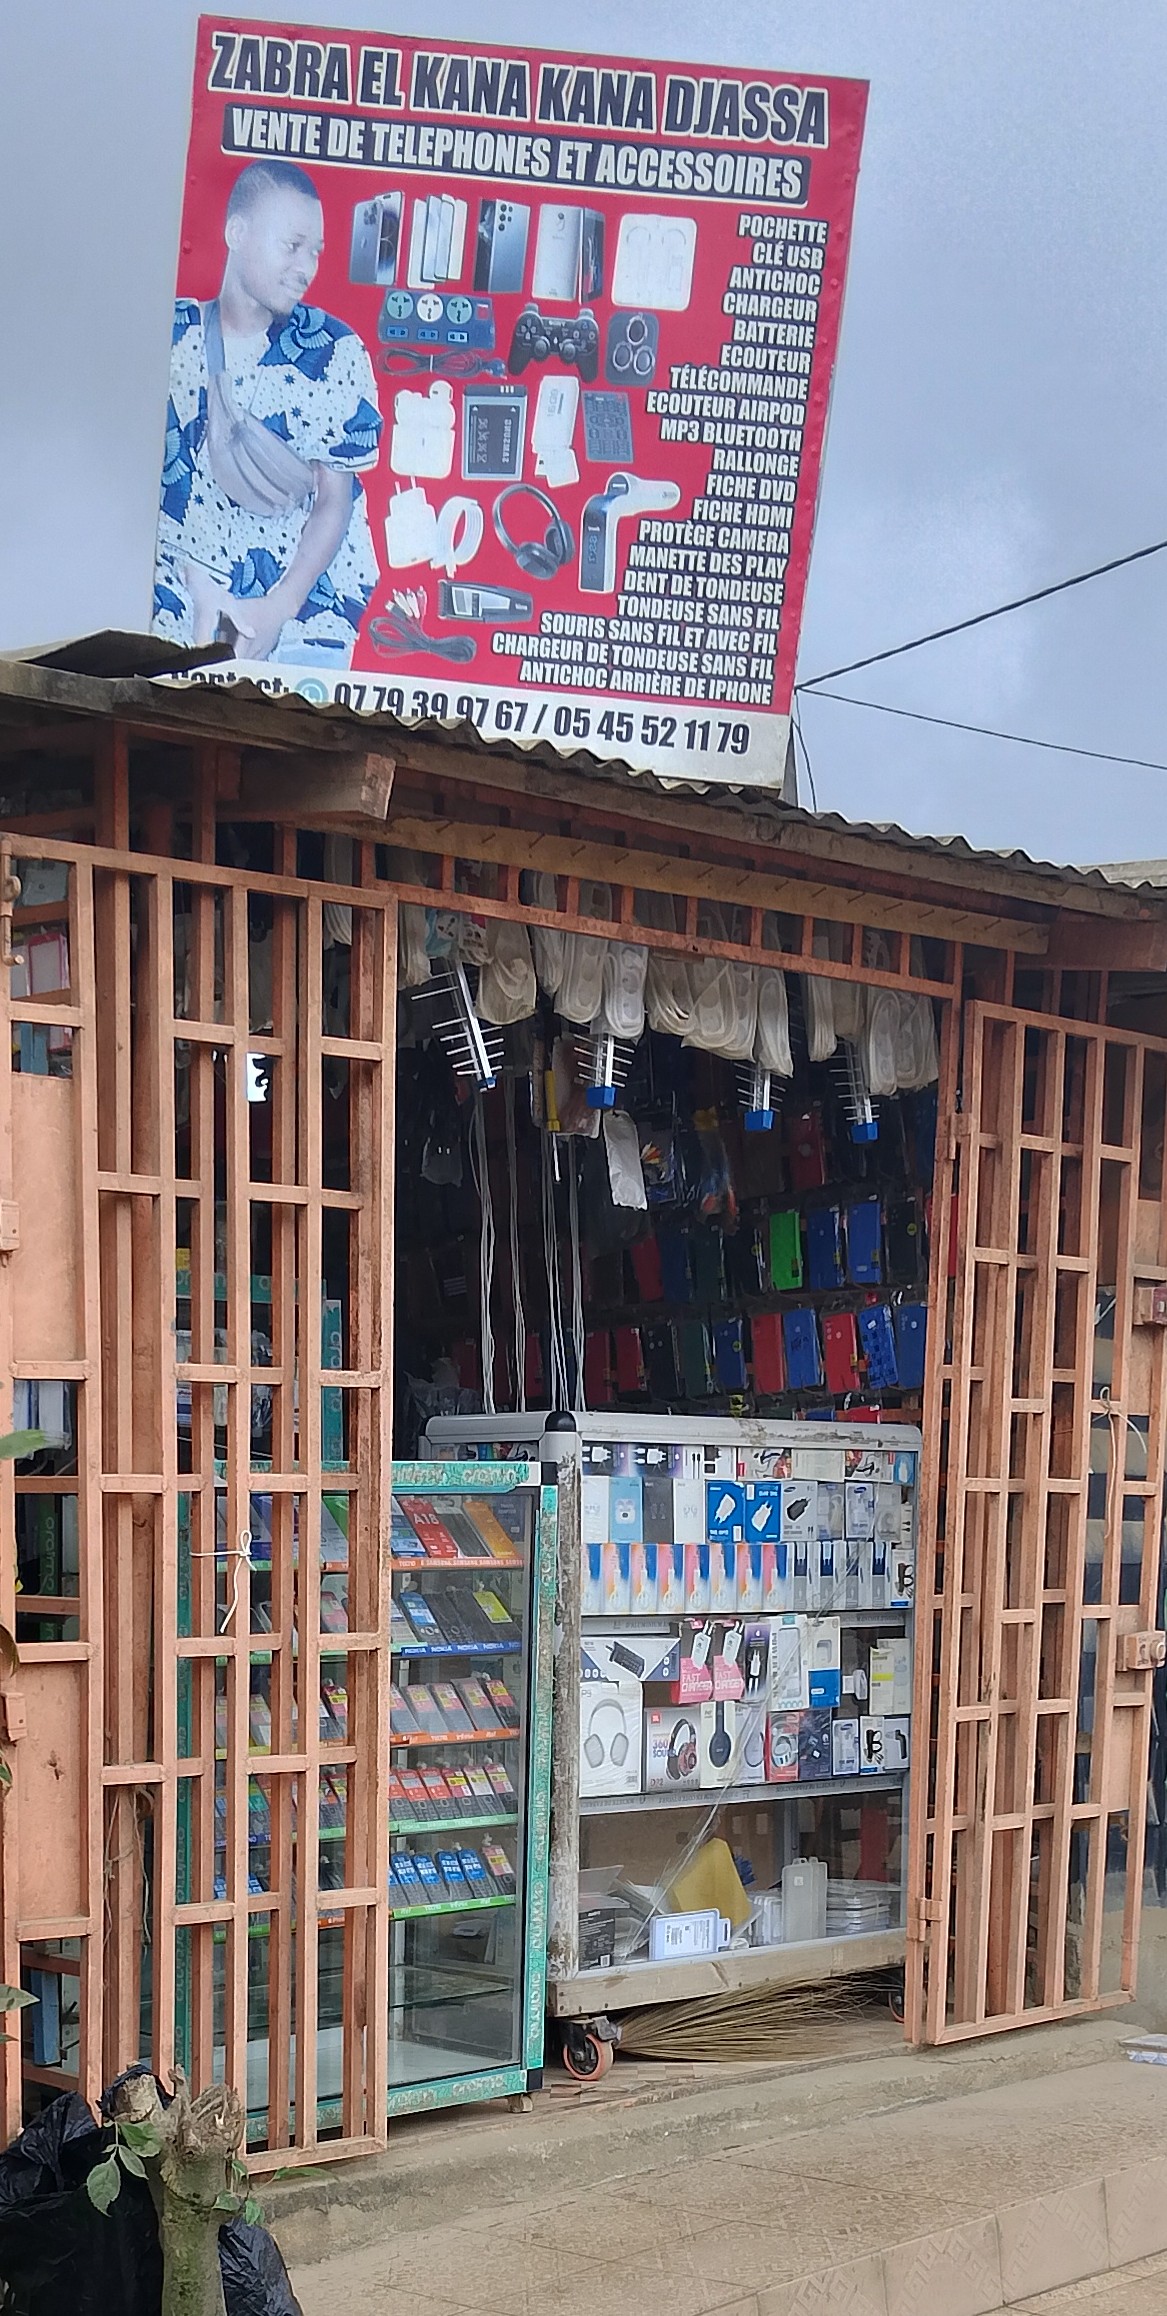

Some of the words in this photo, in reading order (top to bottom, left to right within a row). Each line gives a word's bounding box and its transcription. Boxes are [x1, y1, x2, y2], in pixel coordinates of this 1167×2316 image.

[209, 33, 351, 103] ZABRA
[358, 47, 404, 108] EL
[411, 53, 529, 120] KANA
[537, 65, 655, 131] KANA
[663, 76, 827, 146] DJASSA
[232, 108, 321, 155] VENTE
[327, 117, 364, 159] DE
[372, 122, 551, 177] TELEPHONES
[556, 140, 593, 181] ET
[595, 144, 803, 198] ACCESSOIRES
[738, 214, 828, 244] POCHETTE
[752, 241, 784, 266] CLÉ
[786, 245, 824, 270] USB
[729, 266, 821, 296] ANTICHOC
[722, 292, 819, 322] CHARGEUR
[733, 320, 815, 348] BATTERIE
[720, 345, 812, 374] ECOUTEUR
[670, 364, 809, 400] TÉLÉCOMMANDE
[646, 391, 736, 419] ECOUTEUR
[738, 399, 805, 425] AIRPOD
[660, 418, 699, 442] MP3
[702, 422, 803, 452] BLUETOOTH
[713, 448, 800, 477] RALLONGE
[706, 474, 757, 499] FICHE
[759, 478, 797, 502] DVD
[692, 499, 743, 524] FICHE
[745, 503, 794, 529] HDMI
[638, 519, 715, 547] PROTÈGE
[718, 527, 790, 553] CAMERA
[629, 545, 707, 572] MANETTE
[709, 552, 742, 575] DES
[745, 555, 788, 579] PLAY
[624, 570, 668, 594] DENT
[670, 574, 692, 597] DE
[695, 576, 784, 605] TONDEUSE
[617, 595, 705, 623] TONDEUSE
[707, 603, 753, 628] SANS
[756, 607, 780, 630] FIL
[540, 612, 606, 639] SOURIS
[608, 620, 654, 644] SANS
[656, 623, 681, 647] FIL
[683, 626, 705, 648] ET
[705, 628, 751, 652] AVEC
[752, 632, 777, 655] FIL
[492, 632, 584, 662] CHARGEUR
[586, 642, 609, 664] DE
[611, 644, 699, 673] TONDEUSE
[700, 653, 748, 677] SANS
[749, 657, 774, 680] FIL
[519, 661, 608, 689] ANTICHOC
[609, 670, 682, 697] ARRIÈRE
[684, 677, 706, 699] DE
[708, 679, 772, 705] IPHONE
[334, 682, 366, 711] 07
[373, 686, 404, 718] 79
[411, 689, 448, 719] 39
[456, 694, 490, 728] 97
[495, 700, 529, 732] 67
[531, 704, 549, 734] /
[553, 706, 591, 738] 05
[596, 710, 634, 743] 45
[640, 714, 677, 748] 52
[683, 719, 713, 751] 11
[717, 721, 751, 755] 79
[413, 1513, 439, 1525] A18
[431, 1645, 453, 1653] NOKIA
[457, 1643, 479, 1651] NOKIA
